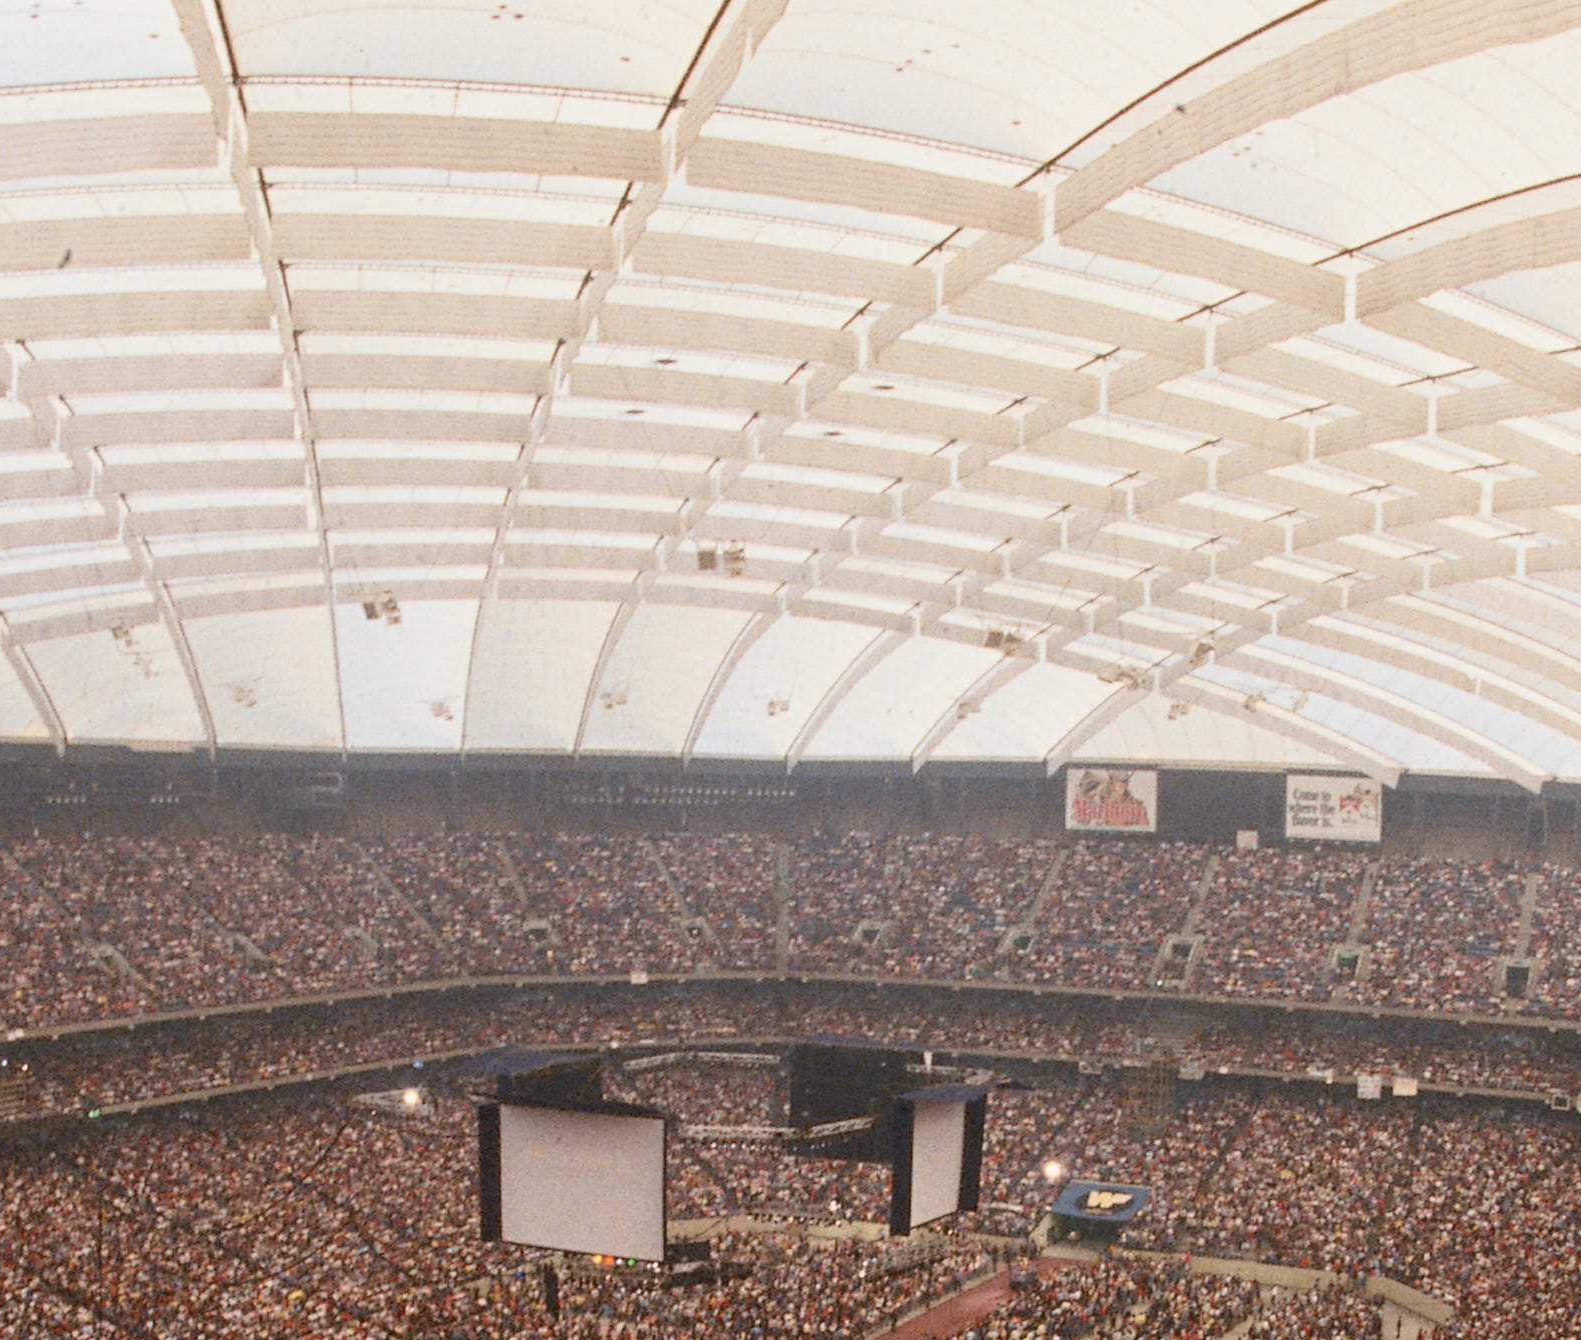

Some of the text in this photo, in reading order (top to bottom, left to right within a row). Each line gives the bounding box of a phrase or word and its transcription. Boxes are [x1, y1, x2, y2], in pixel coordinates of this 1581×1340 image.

[1293, 788, 1331, 801] Come to
[1287, 802, 1335, 815] where the
